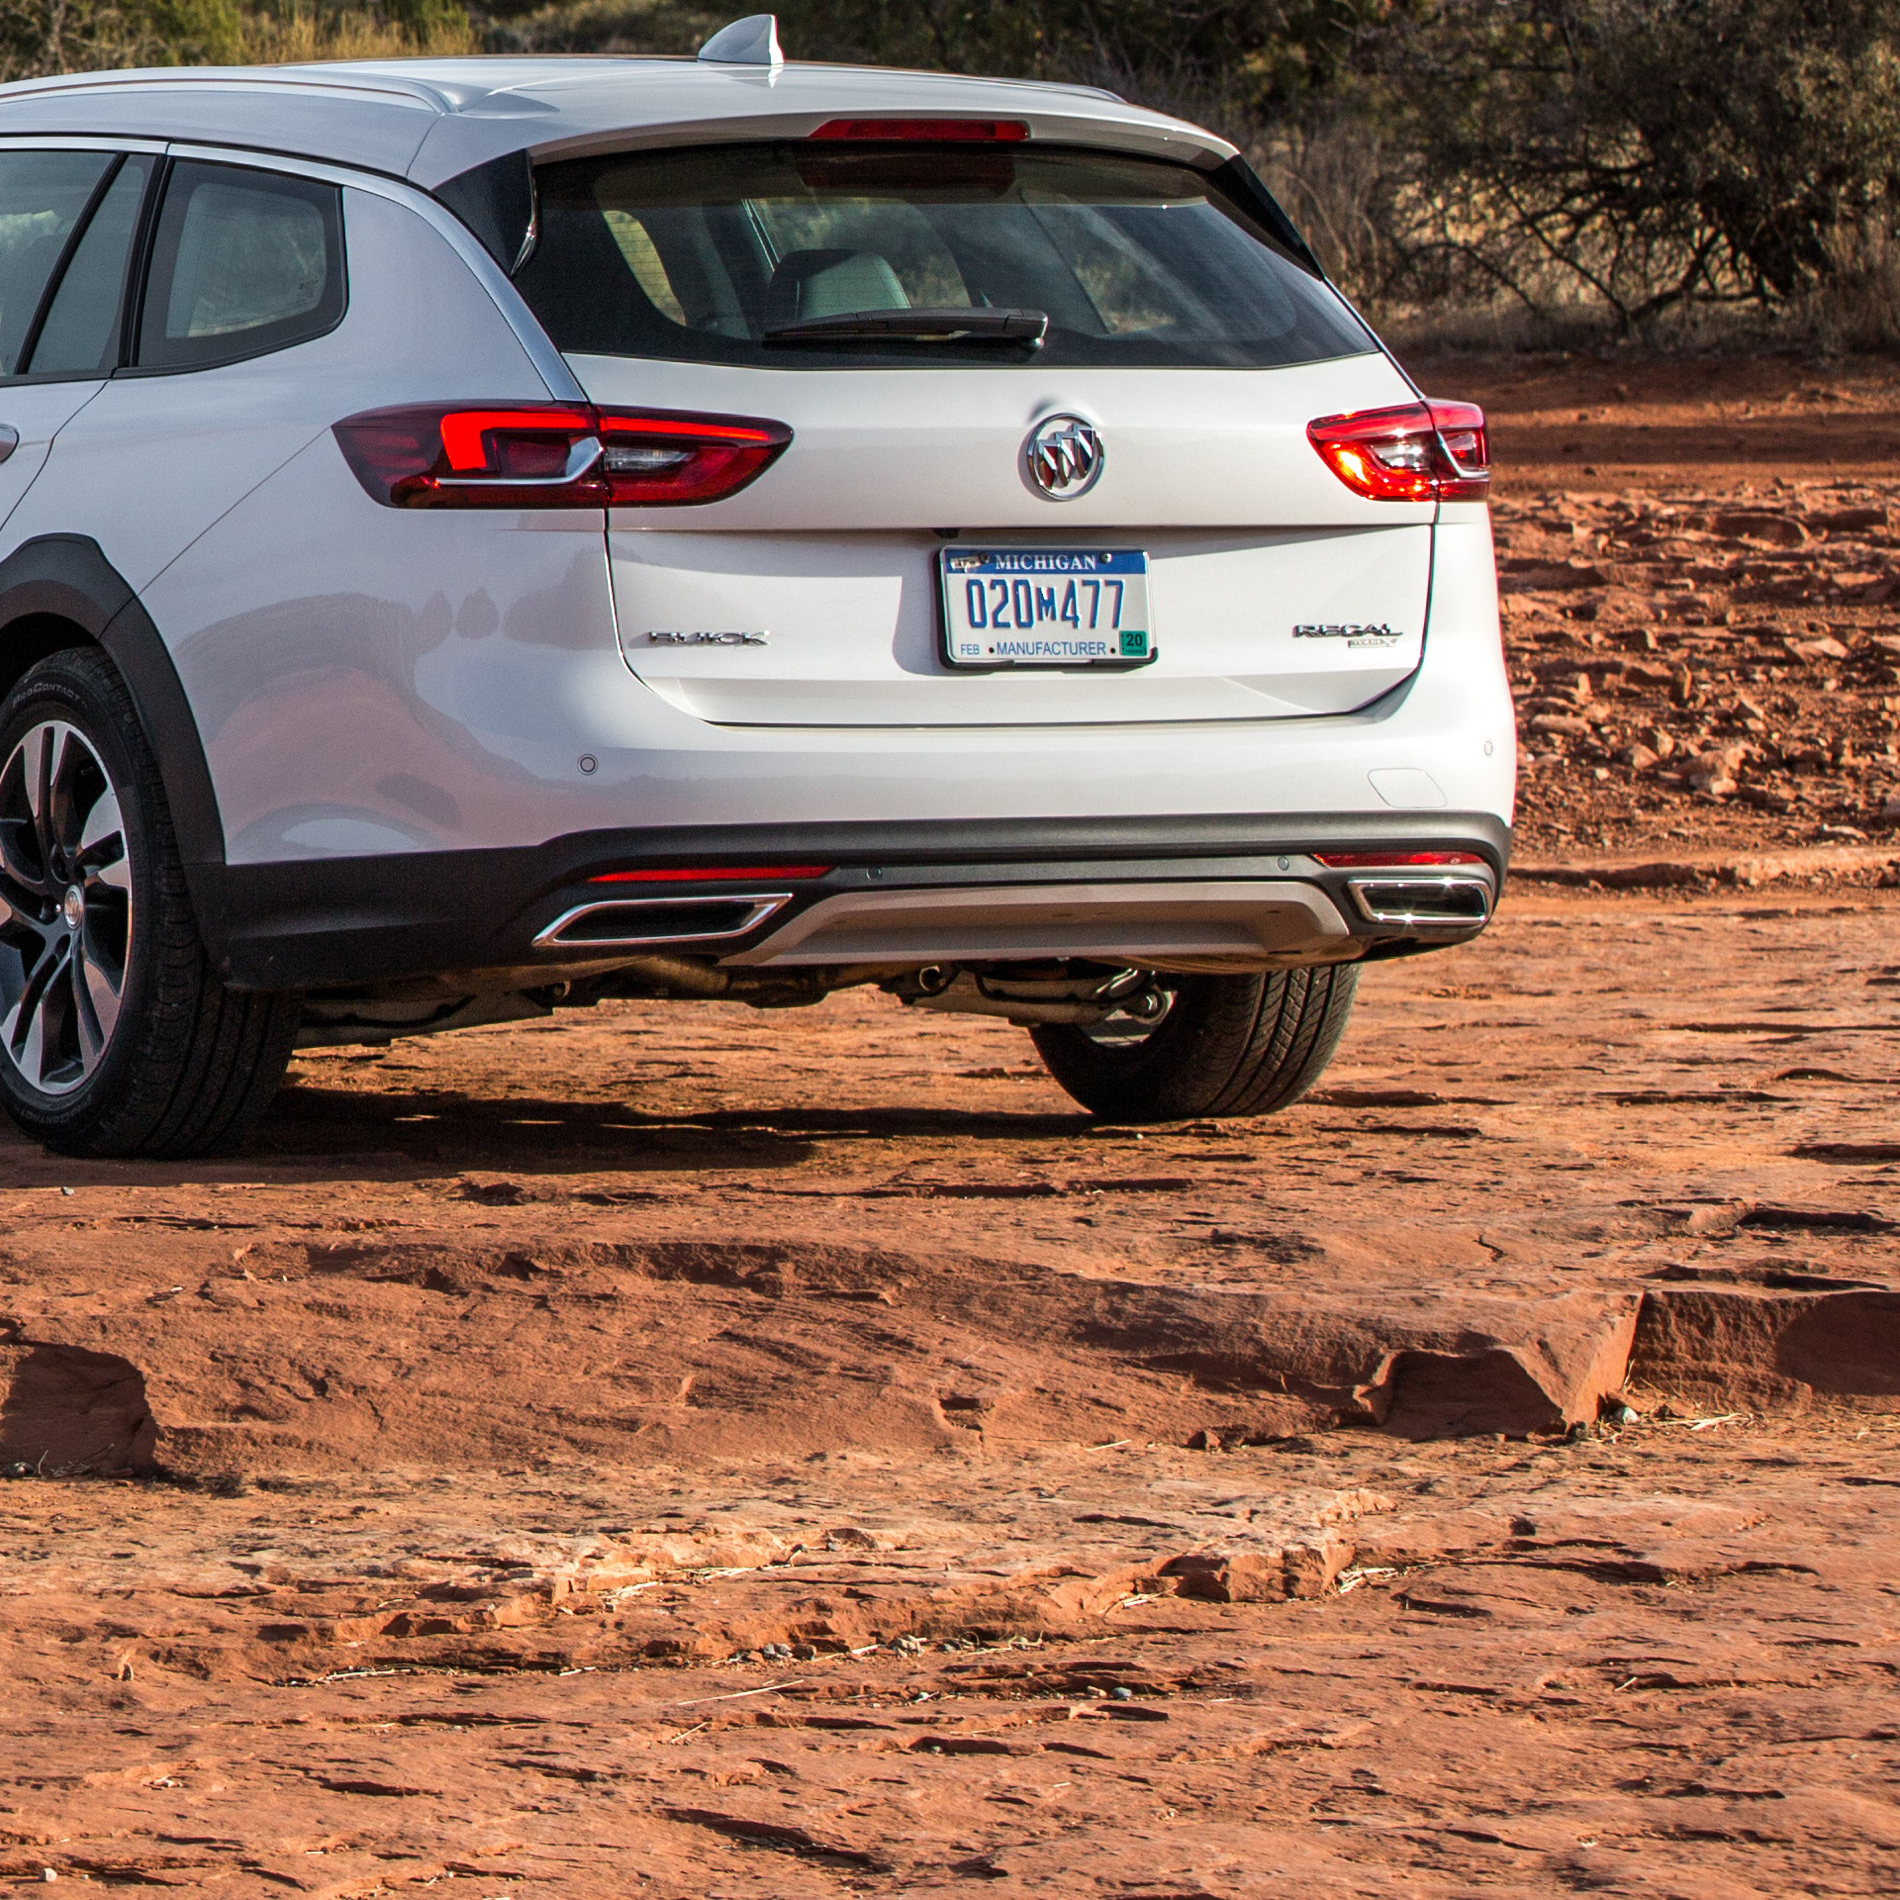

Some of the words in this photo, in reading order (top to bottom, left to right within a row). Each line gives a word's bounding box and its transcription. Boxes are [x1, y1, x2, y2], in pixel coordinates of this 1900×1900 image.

[995, 554, 1097, 571] MICHIGAN
[966, 578, 1126, 629] 020M477
[1293, 623, 1403, 638] REGAL
[961, 643, 980, 655] FEB
[997, 640, 1107, 657] MANUFACTURER
[1126, 633, 1143, 647] 20
